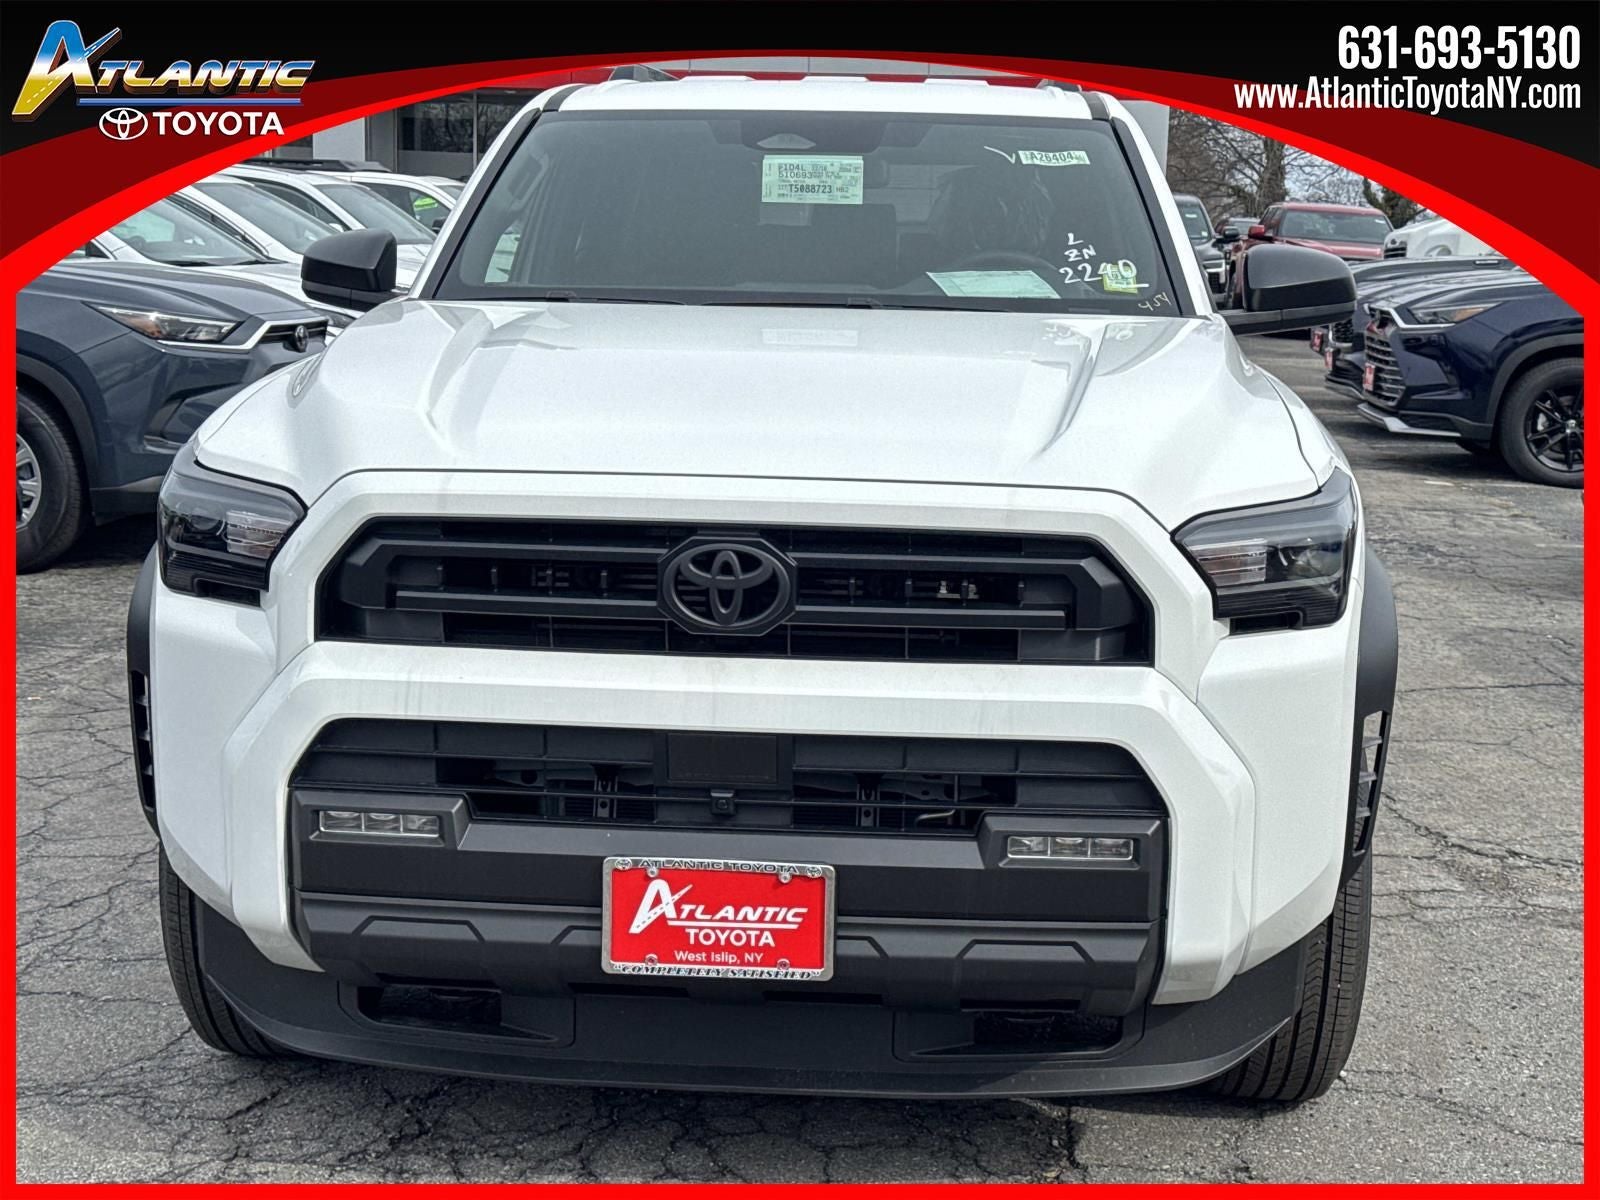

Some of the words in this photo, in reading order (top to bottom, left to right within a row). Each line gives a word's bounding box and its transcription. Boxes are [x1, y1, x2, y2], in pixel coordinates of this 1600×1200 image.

[640, 860, 724, 871] ATLANTIC
[730, 862, 799, 874] TOYOTA
[628, 879, 809, 934] ATLANTIC
[685, 928, 776, 947] TOYOTA
[674, 950, 707, 962] West
[744, 952, 764, 964] NY
